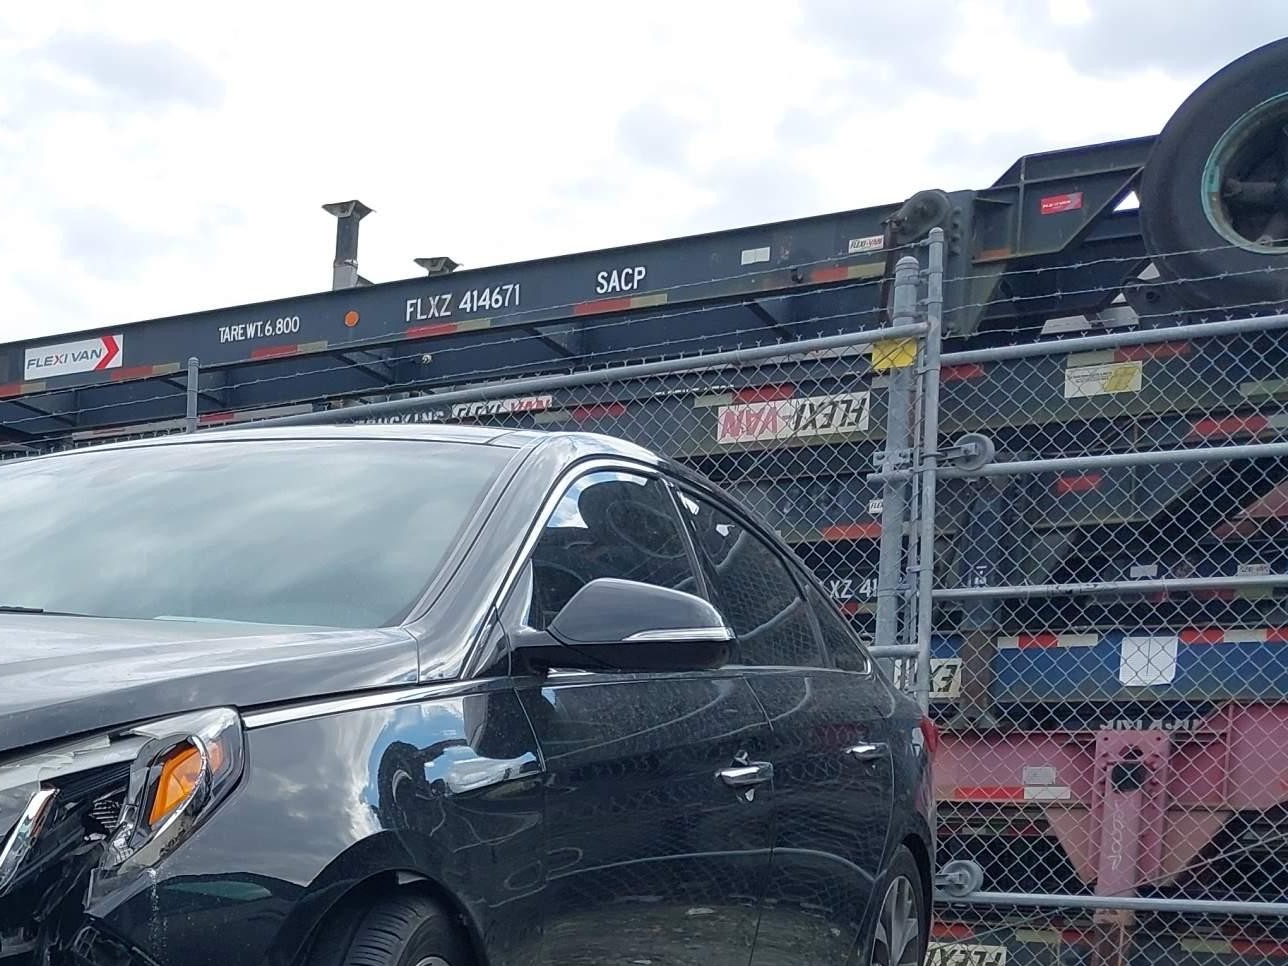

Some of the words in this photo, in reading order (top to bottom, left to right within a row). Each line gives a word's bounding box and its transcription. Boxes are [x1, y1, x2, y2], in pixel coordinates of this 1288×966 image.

[596, 266, 646, 294] SACP
[406, 293, 452, 322] FLXZ
[458, 283, 520, 313] 414671
[218, 324, 245, 343] TARE
[721, 398, 868, 438] FLEXI-VAN
